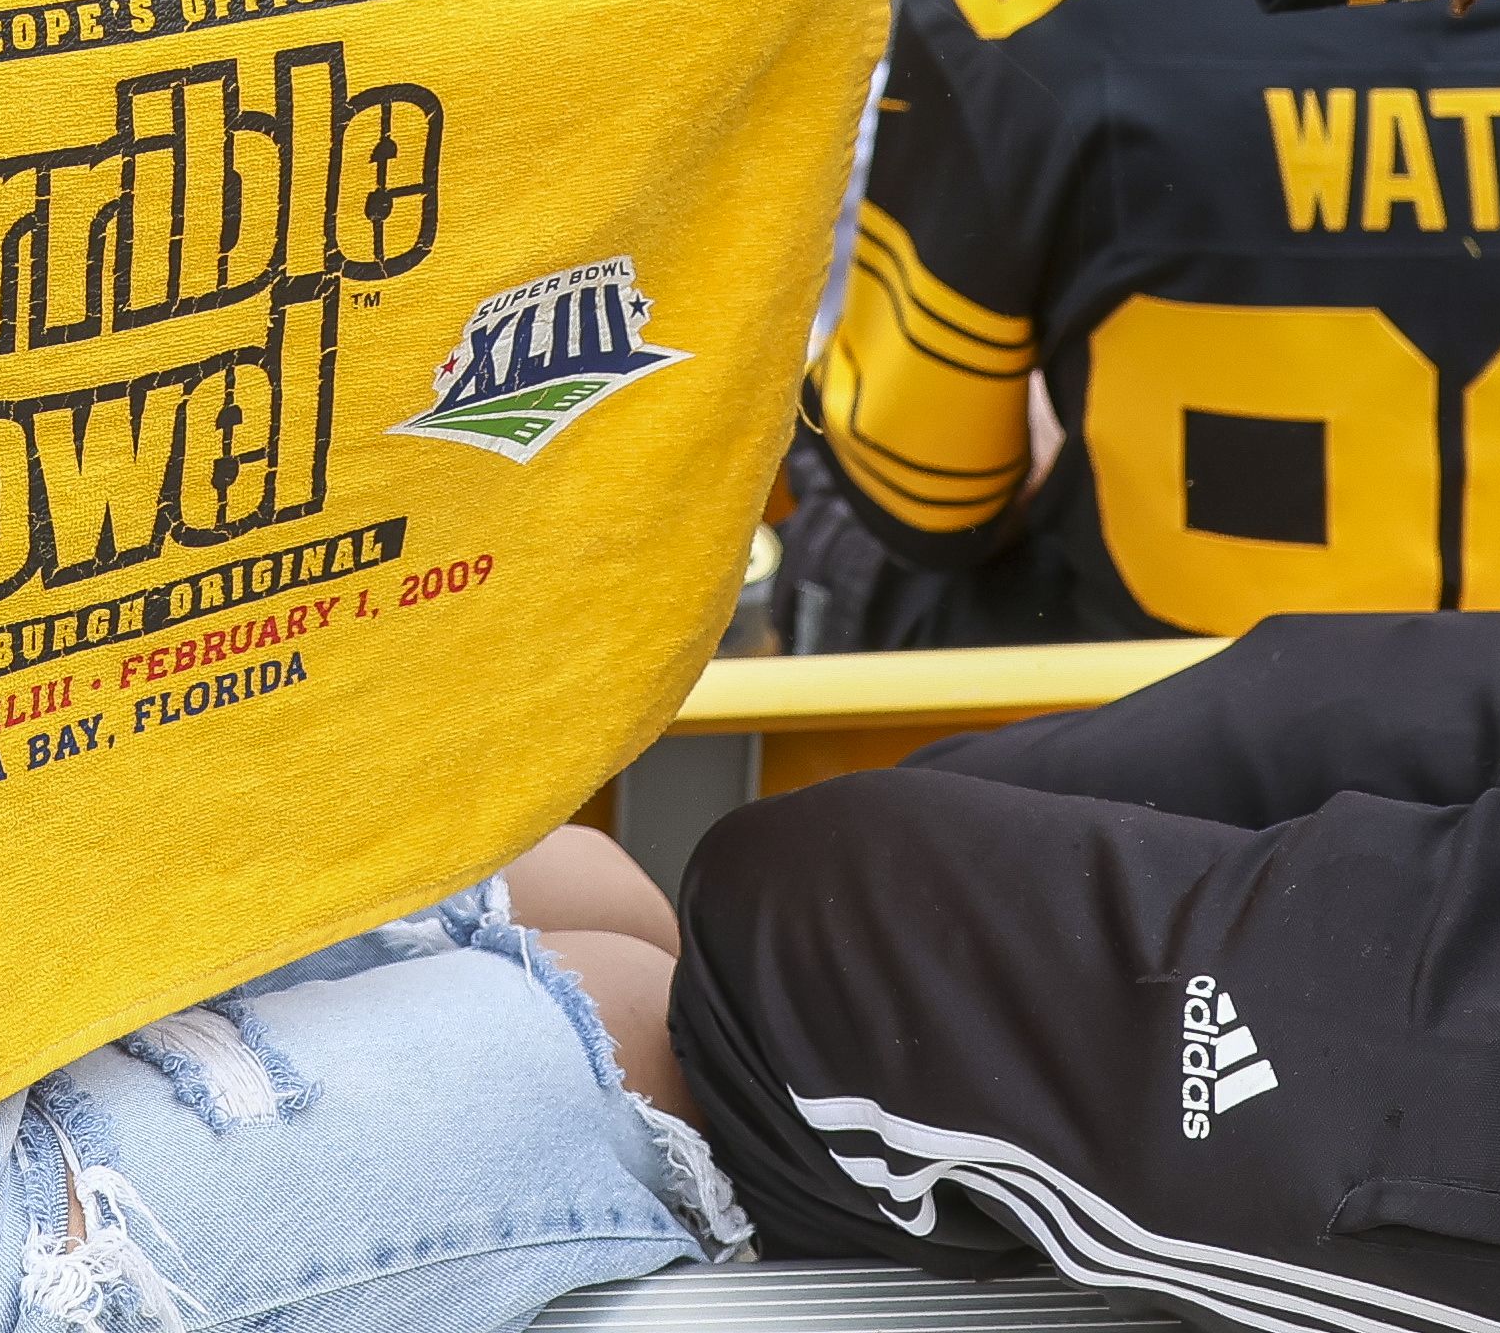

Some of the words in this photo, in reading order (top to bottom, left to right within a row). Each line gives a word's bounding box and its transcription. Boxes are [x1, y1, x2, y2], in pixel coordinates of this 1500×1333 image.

[420, 283, 655, 420] XLIII
[474, 277, 560, 325] SUPER
[569, 259, 631, 286] BOWL
[117, 595, 341, 691] FEBRUARY
[354, 589, 384, 623] 1,
[398, 553, 494, 609] 2009
[168, 532, 386, 624] ORIGINAL
[25, 714, 116, 775] BAY,
[131, 651, 308, 735] FLORIDA
[1182, 975, 1219, 1139] adidas
